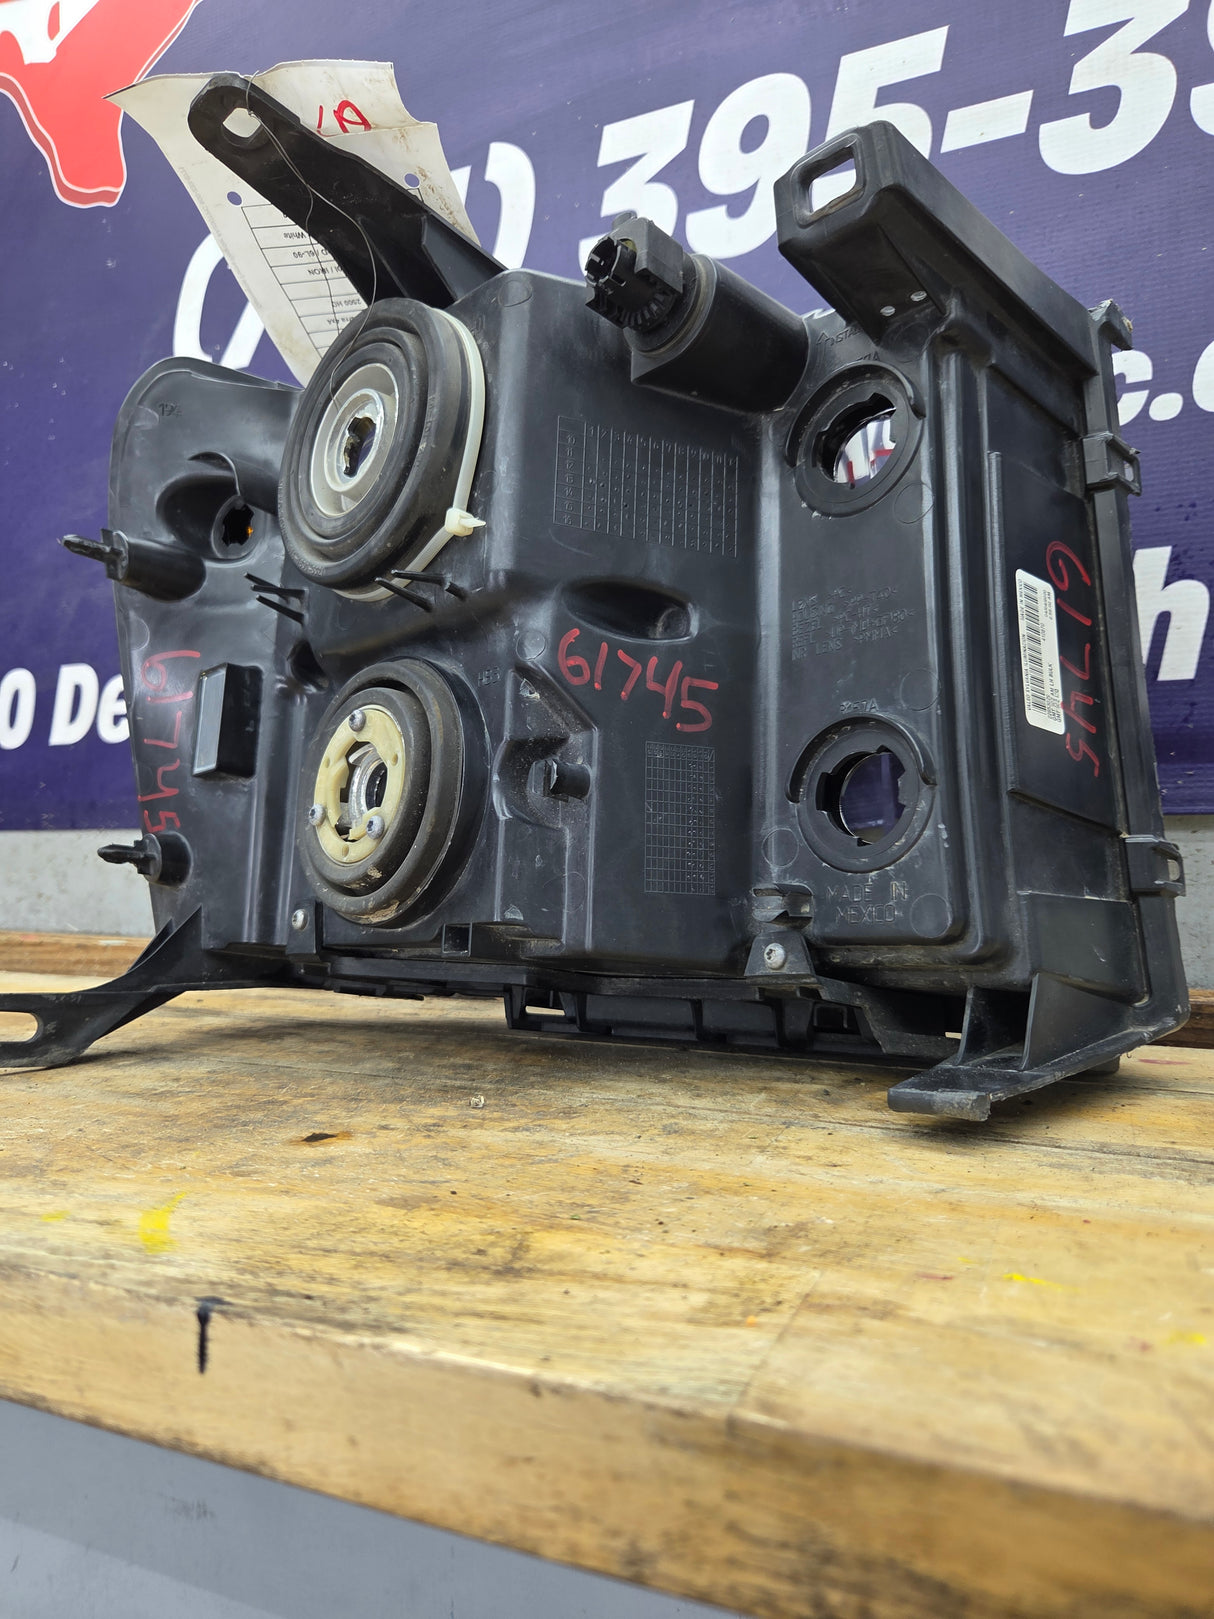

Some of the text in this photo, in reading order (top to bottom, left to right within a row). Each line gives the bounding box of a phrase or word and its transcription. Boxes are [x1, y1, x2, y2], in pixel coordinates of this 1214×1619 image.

[283, 230, 306, 240] White
[558, 628, 719, 732] 61745
[138, 650, 201, 833] 61745
[826, 881, 908, 903] MADE IN
[836, 904, 896, 925] MEXICO
